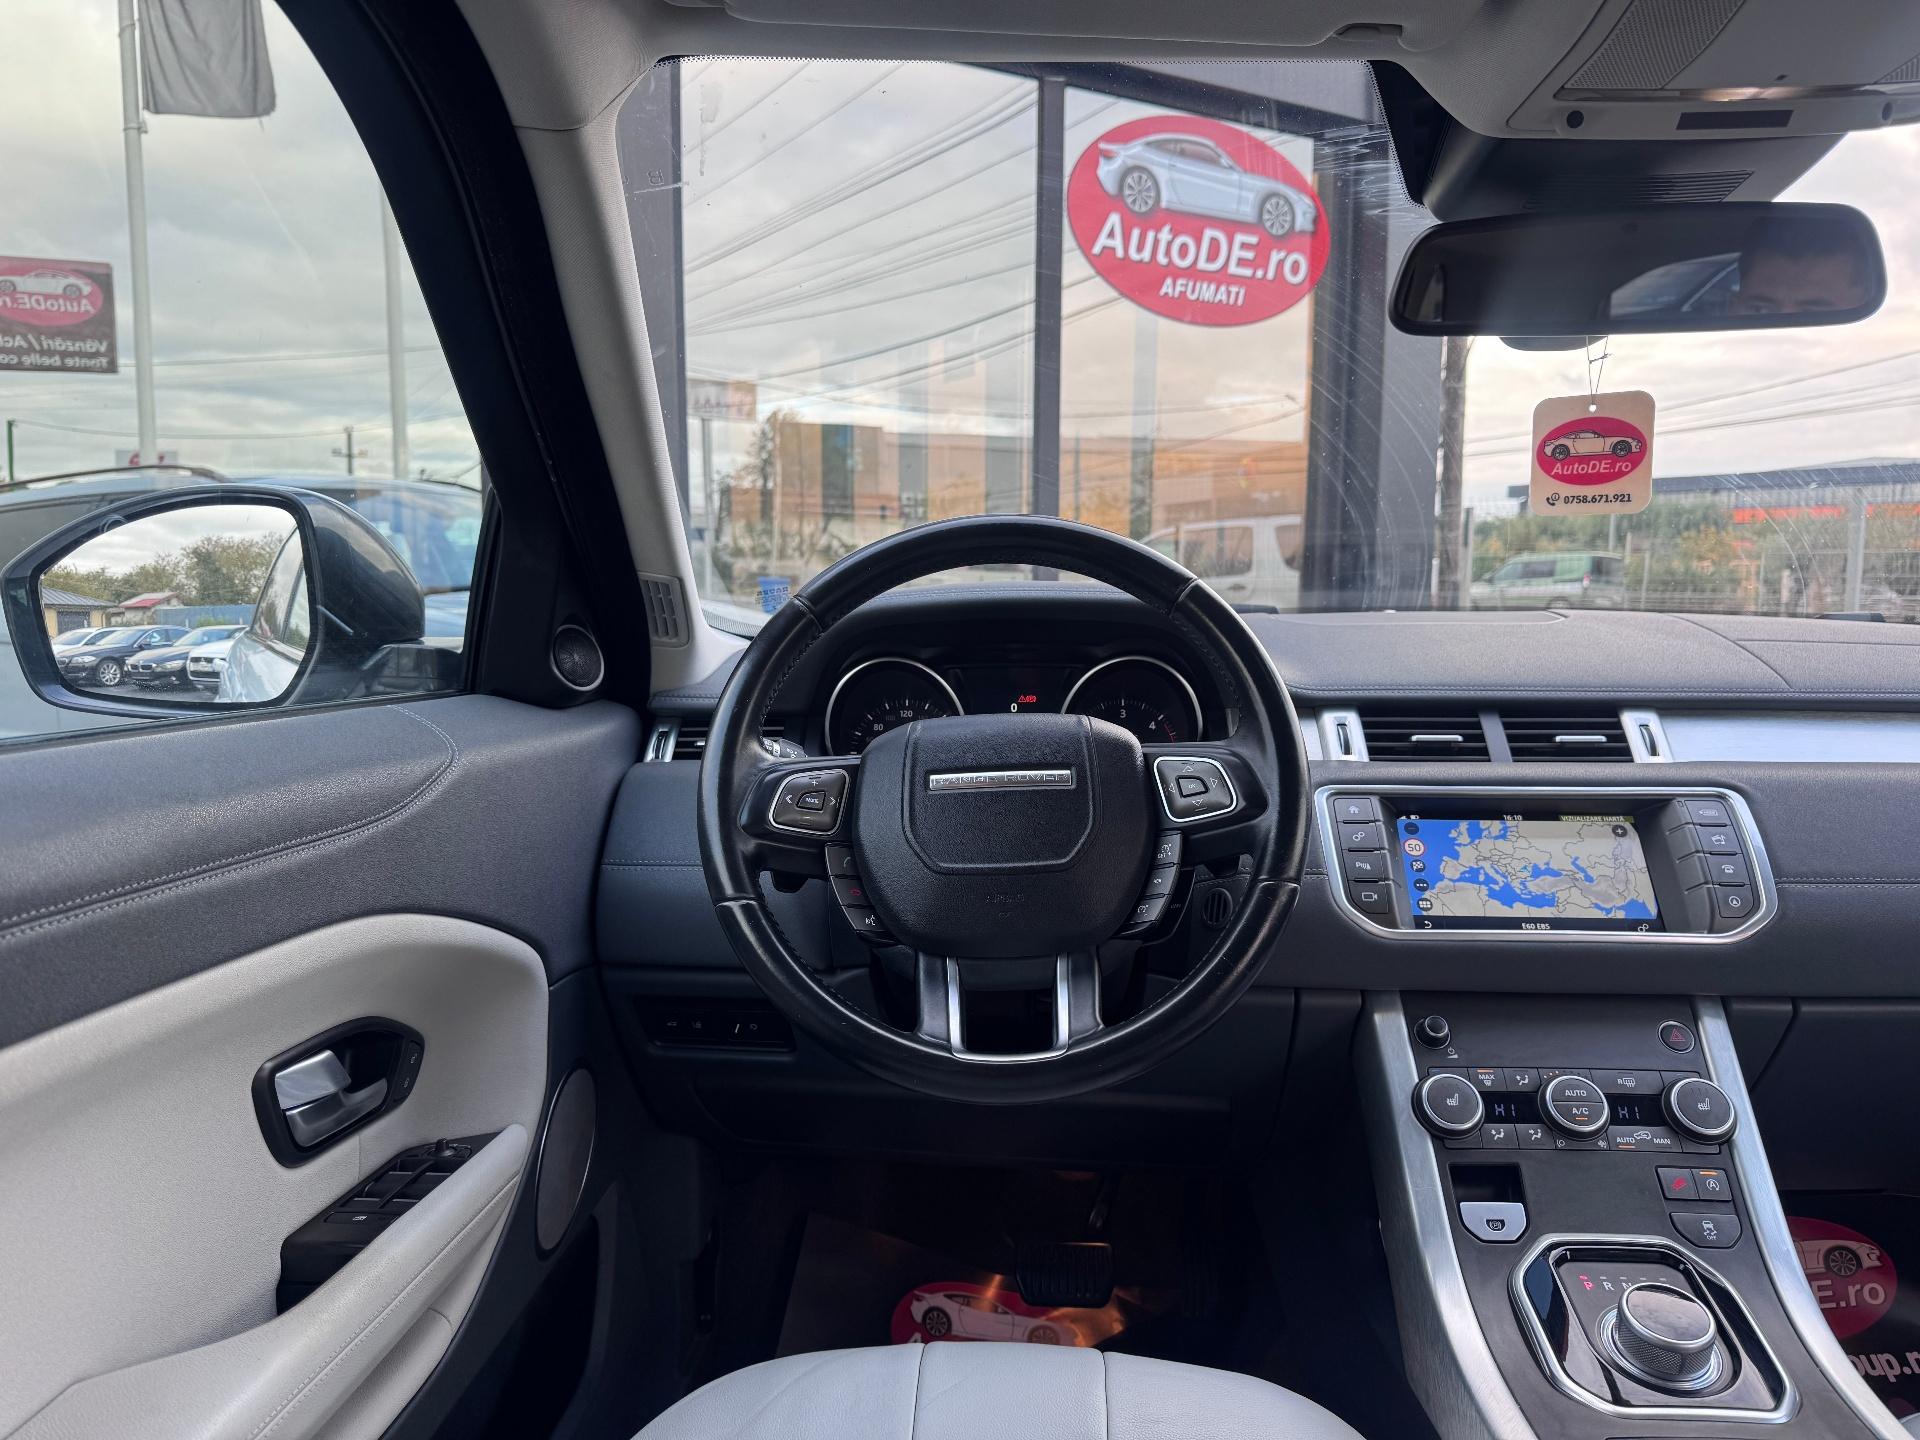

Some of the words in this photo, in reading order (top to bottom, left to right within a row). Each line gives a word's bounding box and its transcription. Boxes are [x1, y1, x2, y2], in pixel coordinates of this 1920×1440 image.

[1092, 211, 1309, 285] AutoDE.ro
[1159, 276, 1246, 306] AFUMATI
[1551, 460, 1632, 476] AutoDE.ro
[1563, 493, 1632, 505] 0758.671.921
[900, 710, 913, 718] 120
[1119, 709, 1127, 719] 3
[873, 723, 884, 731] 80
[1004, 772, 1069, 783] ROVER
[1407, 843, 1421, 852] 50
[1565, 1089, 1587, 1097] AUTO
[1572, 1107, 1589, 1115] A/C
[1616, 1136, 1635, 1144] AUTO
[1583, 1281, 1594, 1290] P
[1602, 1281, 1615, 1291] R
[1811, 1279, 1886, 1310] E.ro
